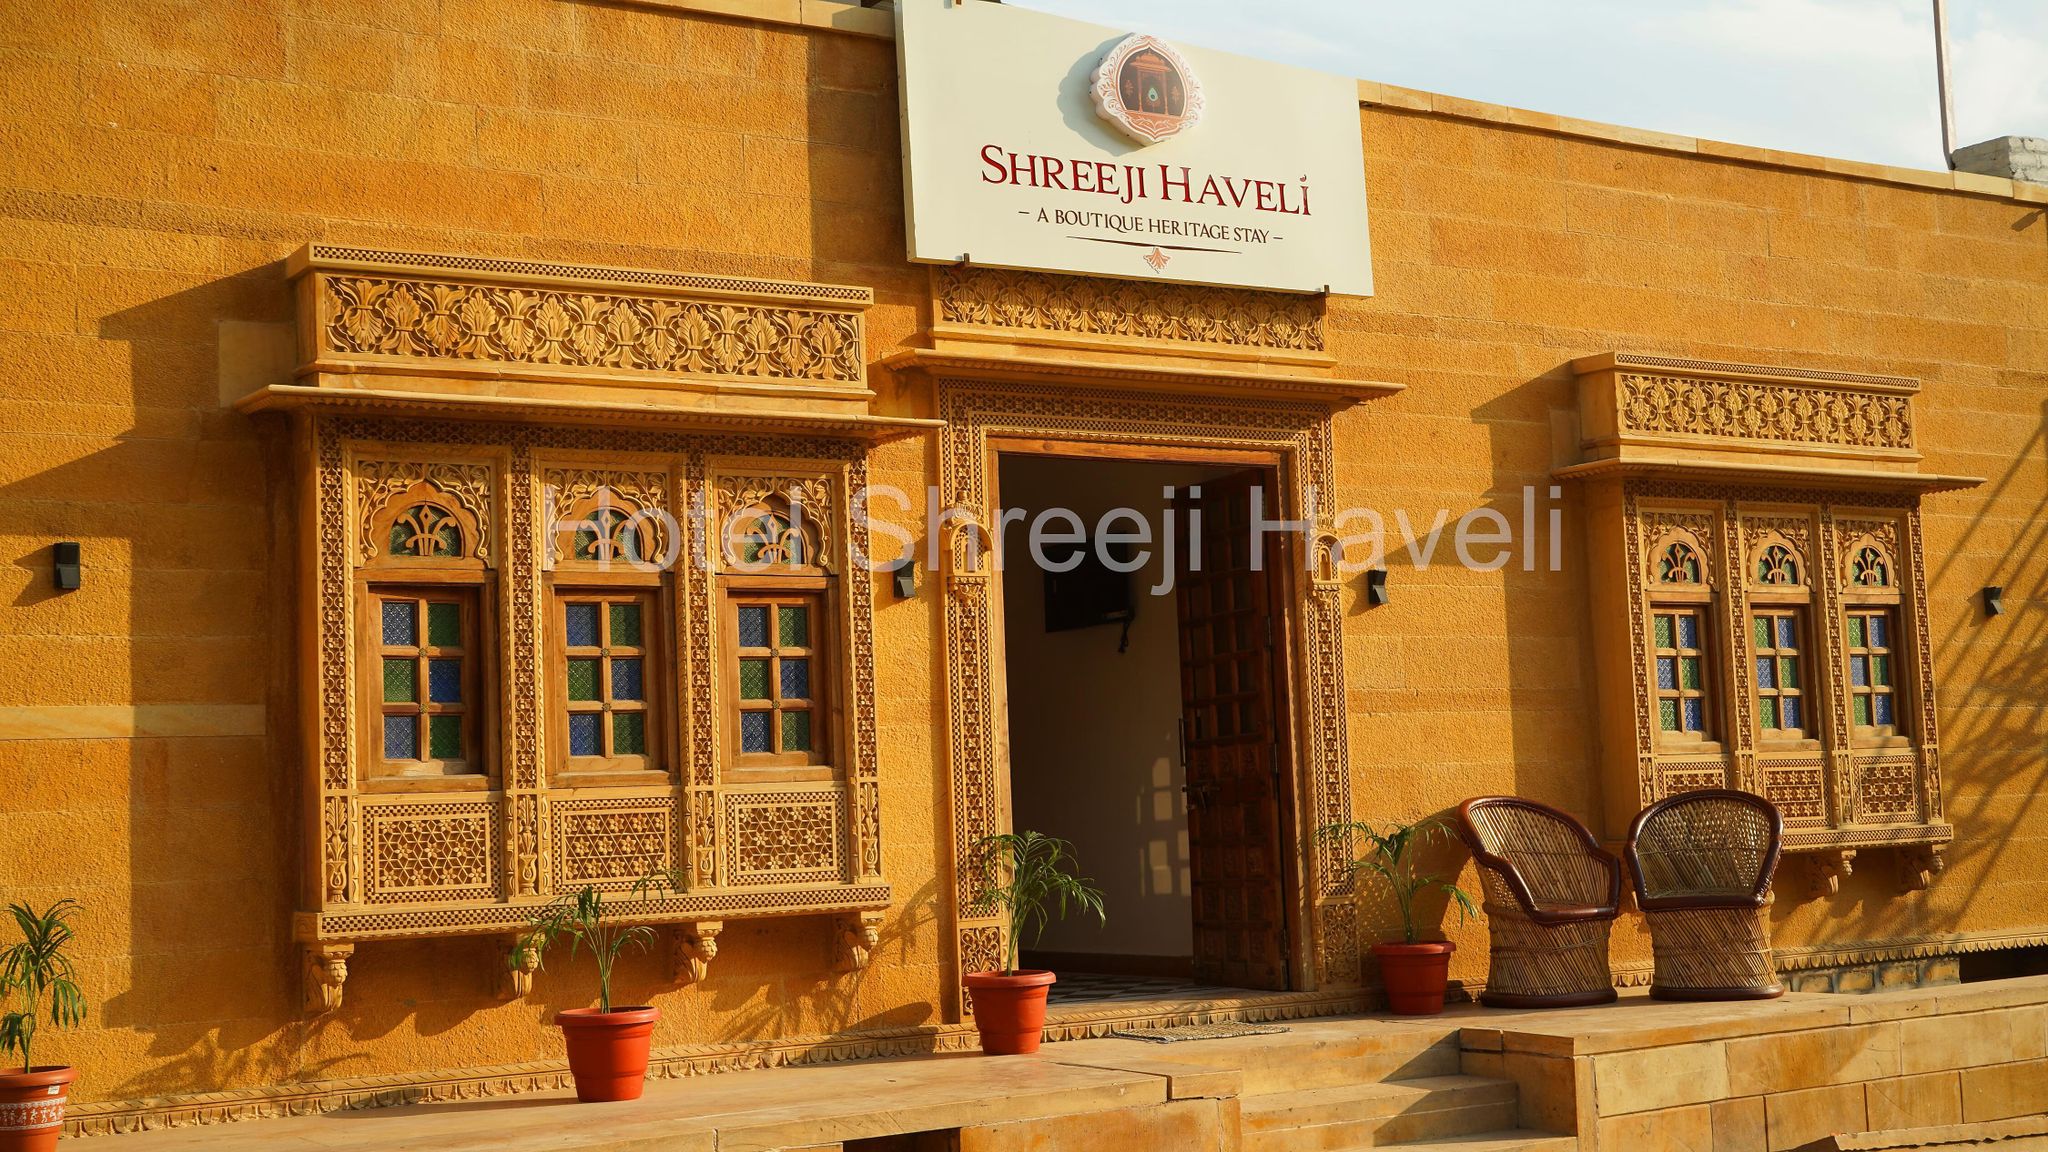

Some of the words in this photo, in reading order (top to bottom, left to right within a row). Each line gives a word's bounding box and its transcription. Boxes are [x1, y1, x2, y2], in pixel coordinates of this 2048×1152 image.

[980, 144, 1148, 205] SHREEJI
[1037, 207, 1050, 223] A
[1054, 208, 1144, 234] BOUTIQUE
[1148, 217, 1230, 241] HERITAGE
[1233, 226, 1270, 244] STAY
